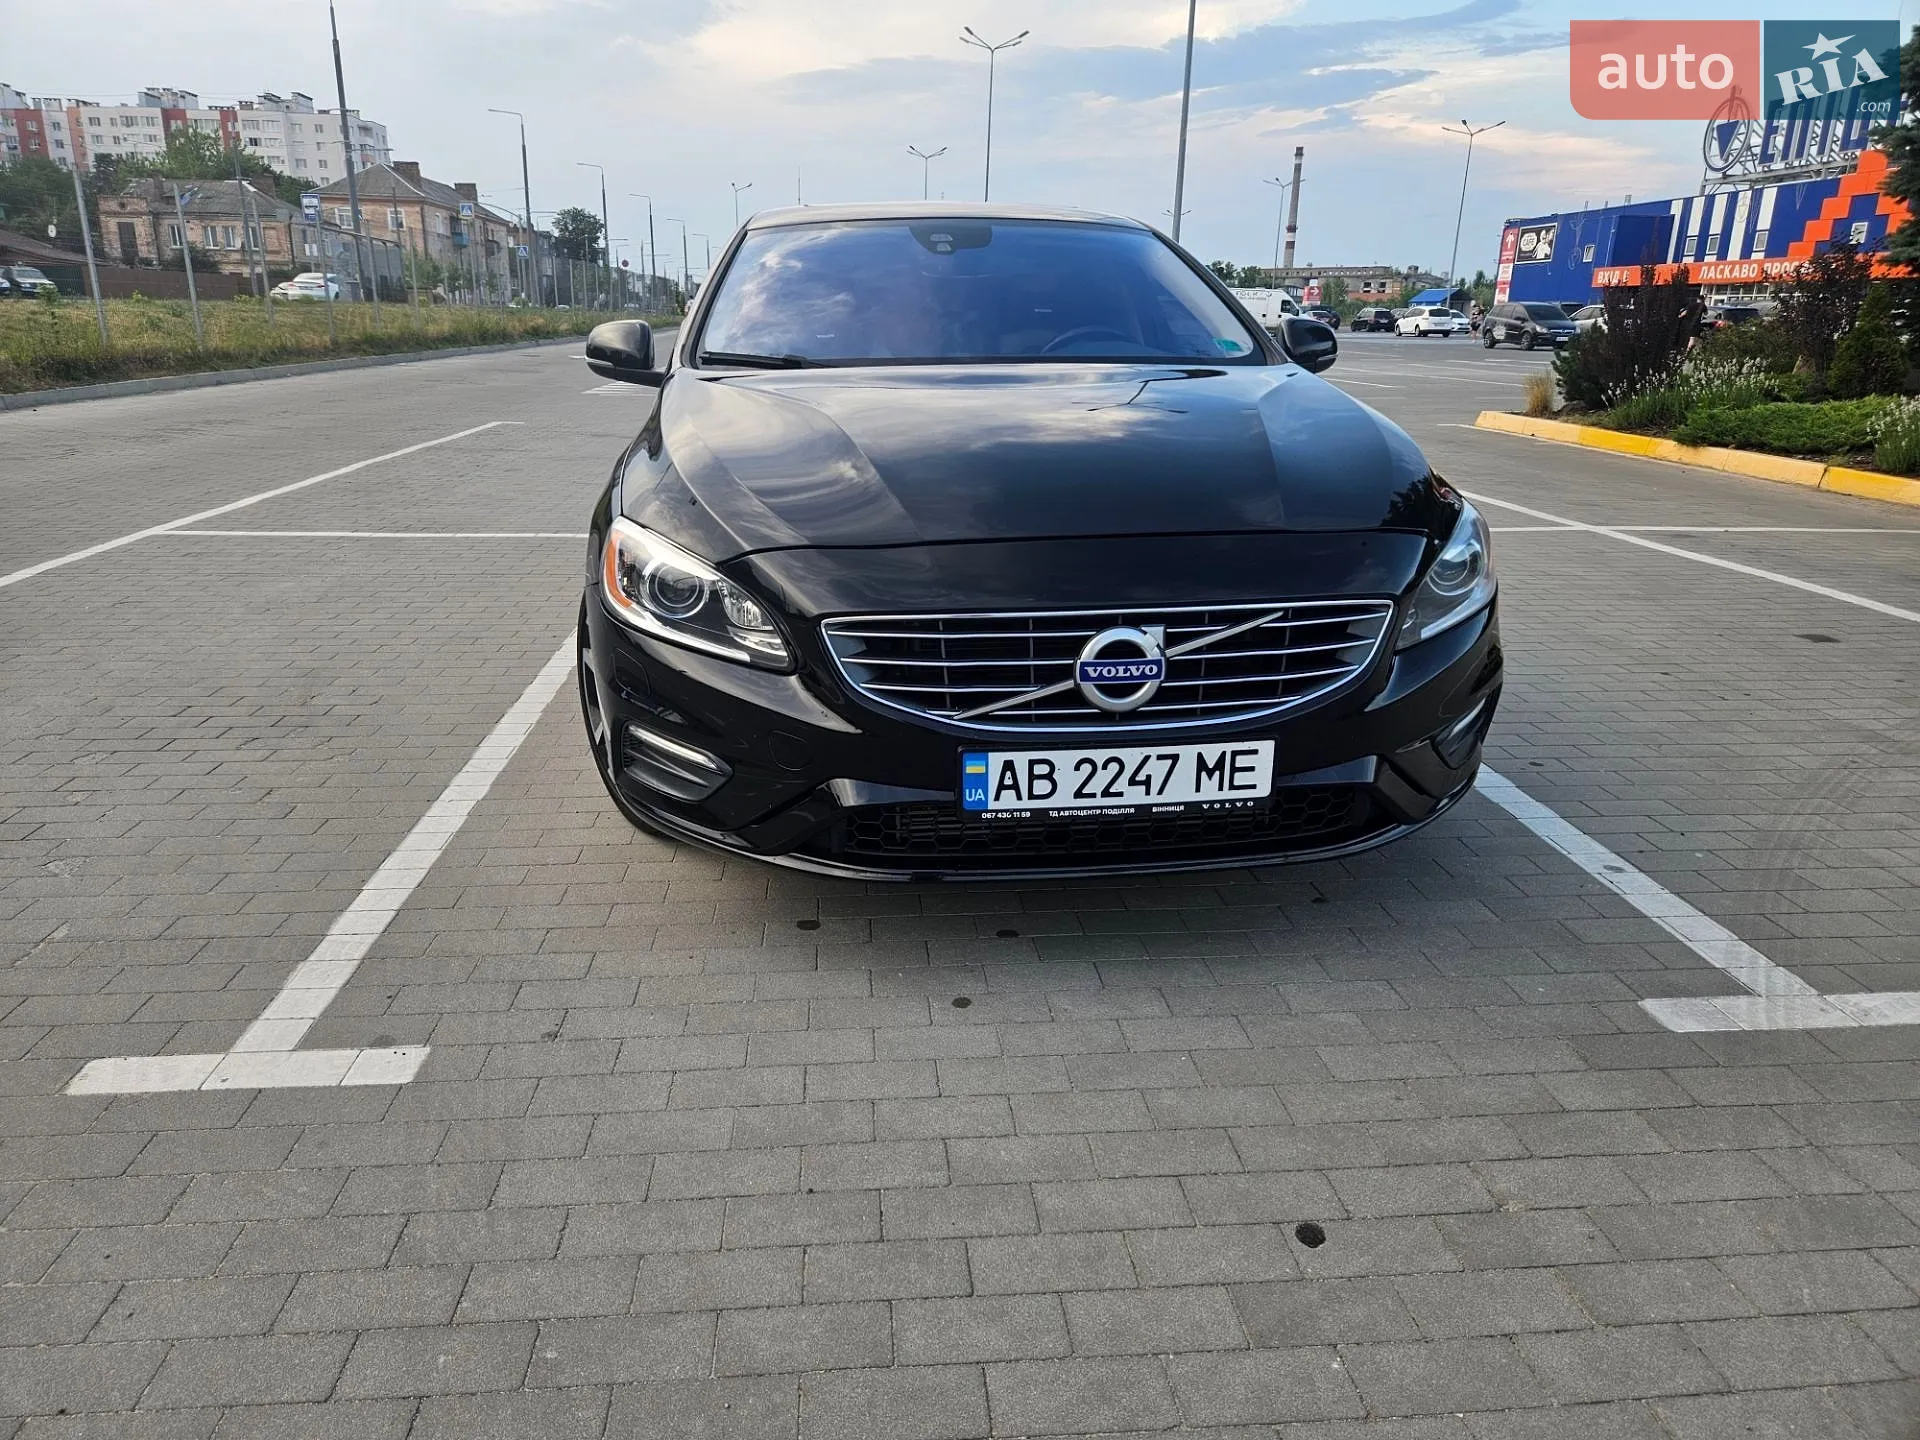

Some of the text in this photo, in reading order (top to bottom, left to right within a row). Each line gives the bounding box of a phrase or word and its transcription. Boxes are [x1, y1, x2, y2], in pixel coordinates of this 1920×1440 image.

[1698, 263, 1758, 280] ЛАСКАВО
[1083, 664, 1158, 678] VOLVO
[994, 748, 1259, 801] AB 2247 ME
[965, 788, 985, 801] UA
[1102, 807, 1135, 816] ПОДІЛЛЯ
[1152, 805, 1184, 813] ВІННИЦЯ
[1202, 801, 1254, 809] VOLVO
